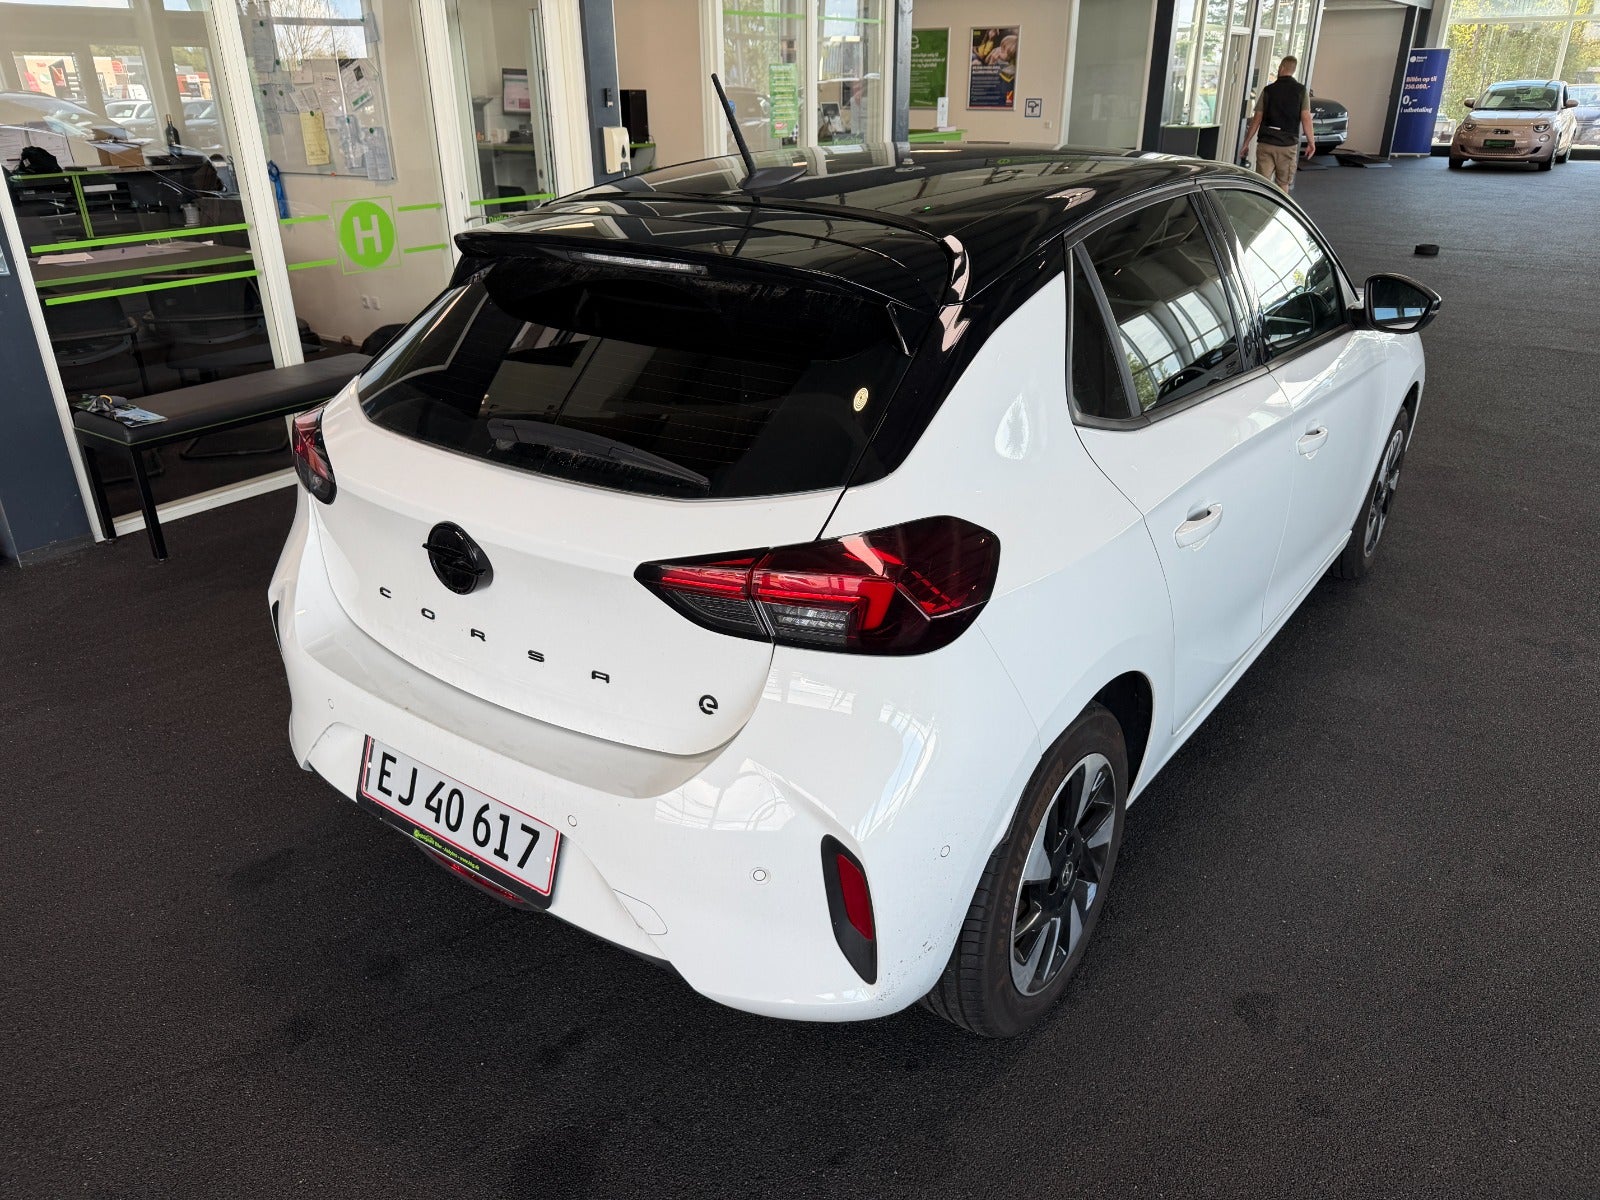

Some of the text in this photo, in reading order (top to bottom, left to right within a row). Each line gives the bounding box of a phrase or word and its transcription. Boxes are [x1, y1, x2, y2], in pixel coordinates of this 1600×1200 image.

[352, 214, 382, 256] H
[379, 586, 610, 684] CORSA
[377, 751, 418, 806] EJ
[424, 780, 464, 833] 40
[472, 802, 541, 870] 617
